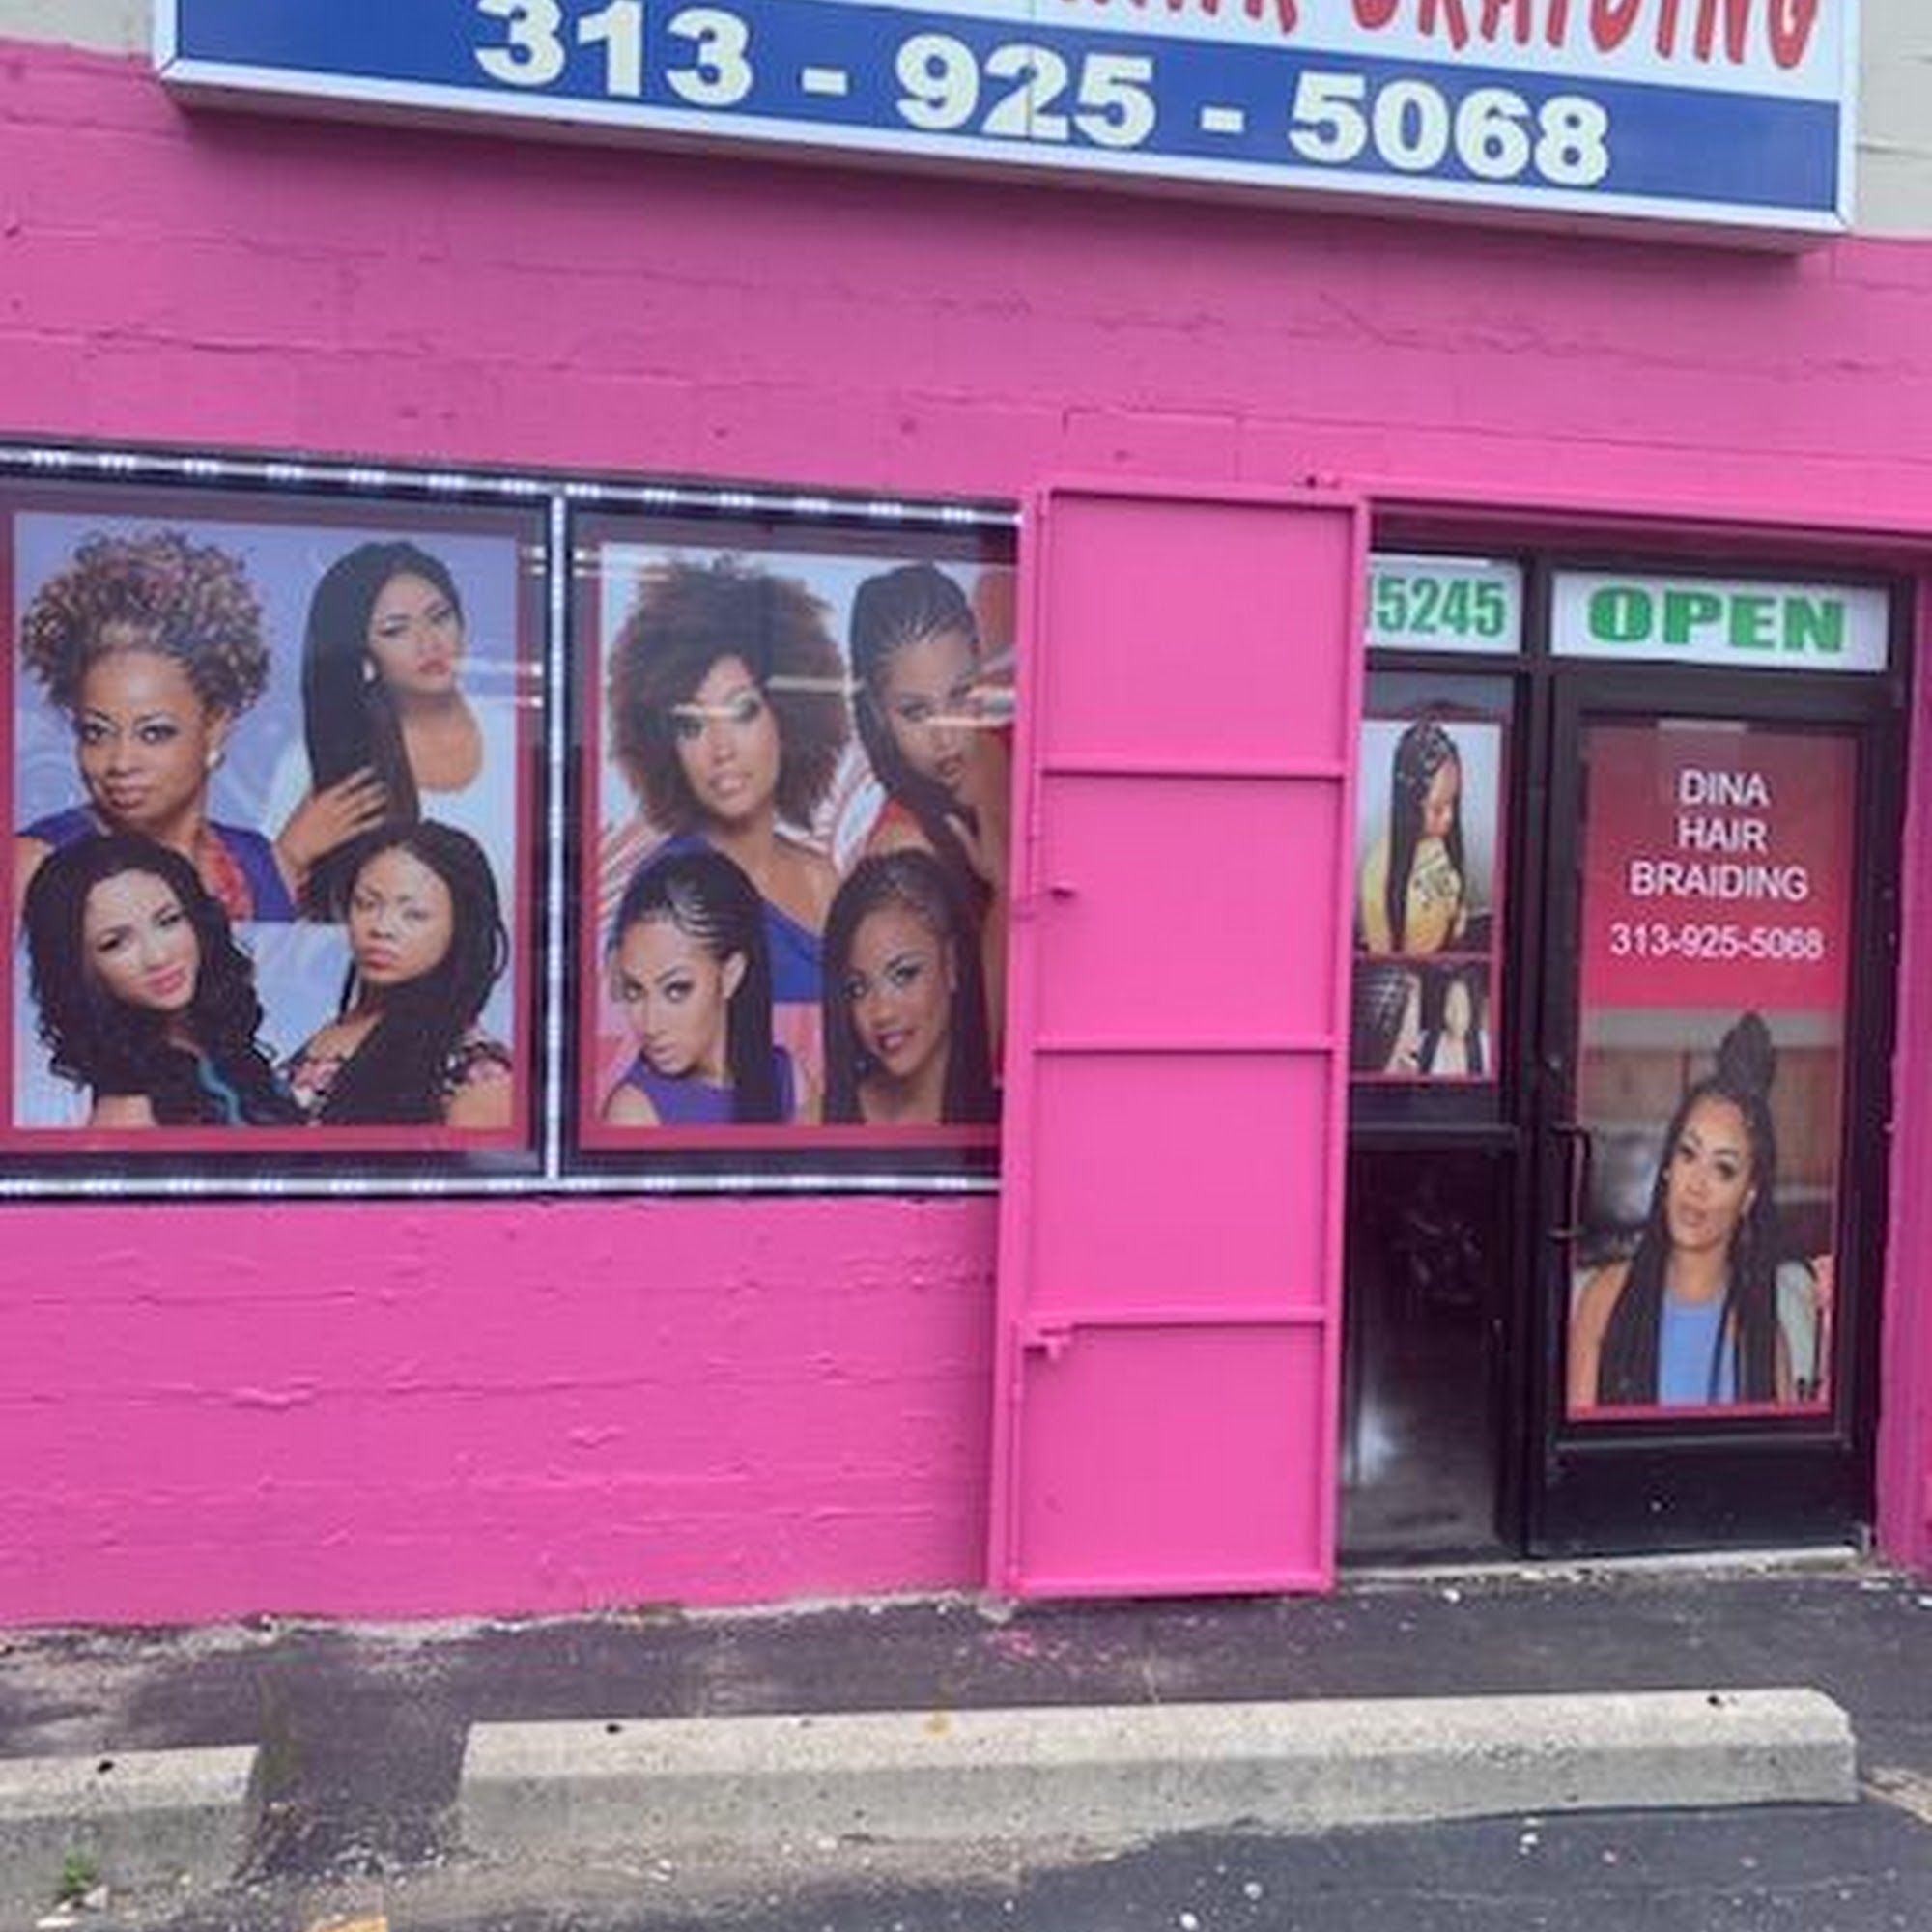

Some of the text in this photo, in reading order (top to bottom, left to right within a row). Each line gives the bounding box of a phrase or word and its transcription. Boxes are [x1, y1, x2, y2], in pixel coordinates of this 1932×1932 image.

[473, 0, 753, 106] 313
[895, 33, 1156, 147] 925
[1288, 70, 1609, 186] 5068
[1366, 574, 1505, 639] 5245
[1587, 585, 1846, 653] OPEN
[1678, 770, 1769, 806] DINA
[1678, 817, 1767, 853] HAIR
[1630, 862, 1809, 901] BRAIDING
[1610, 923, 1824, 960] 313-925-5068
